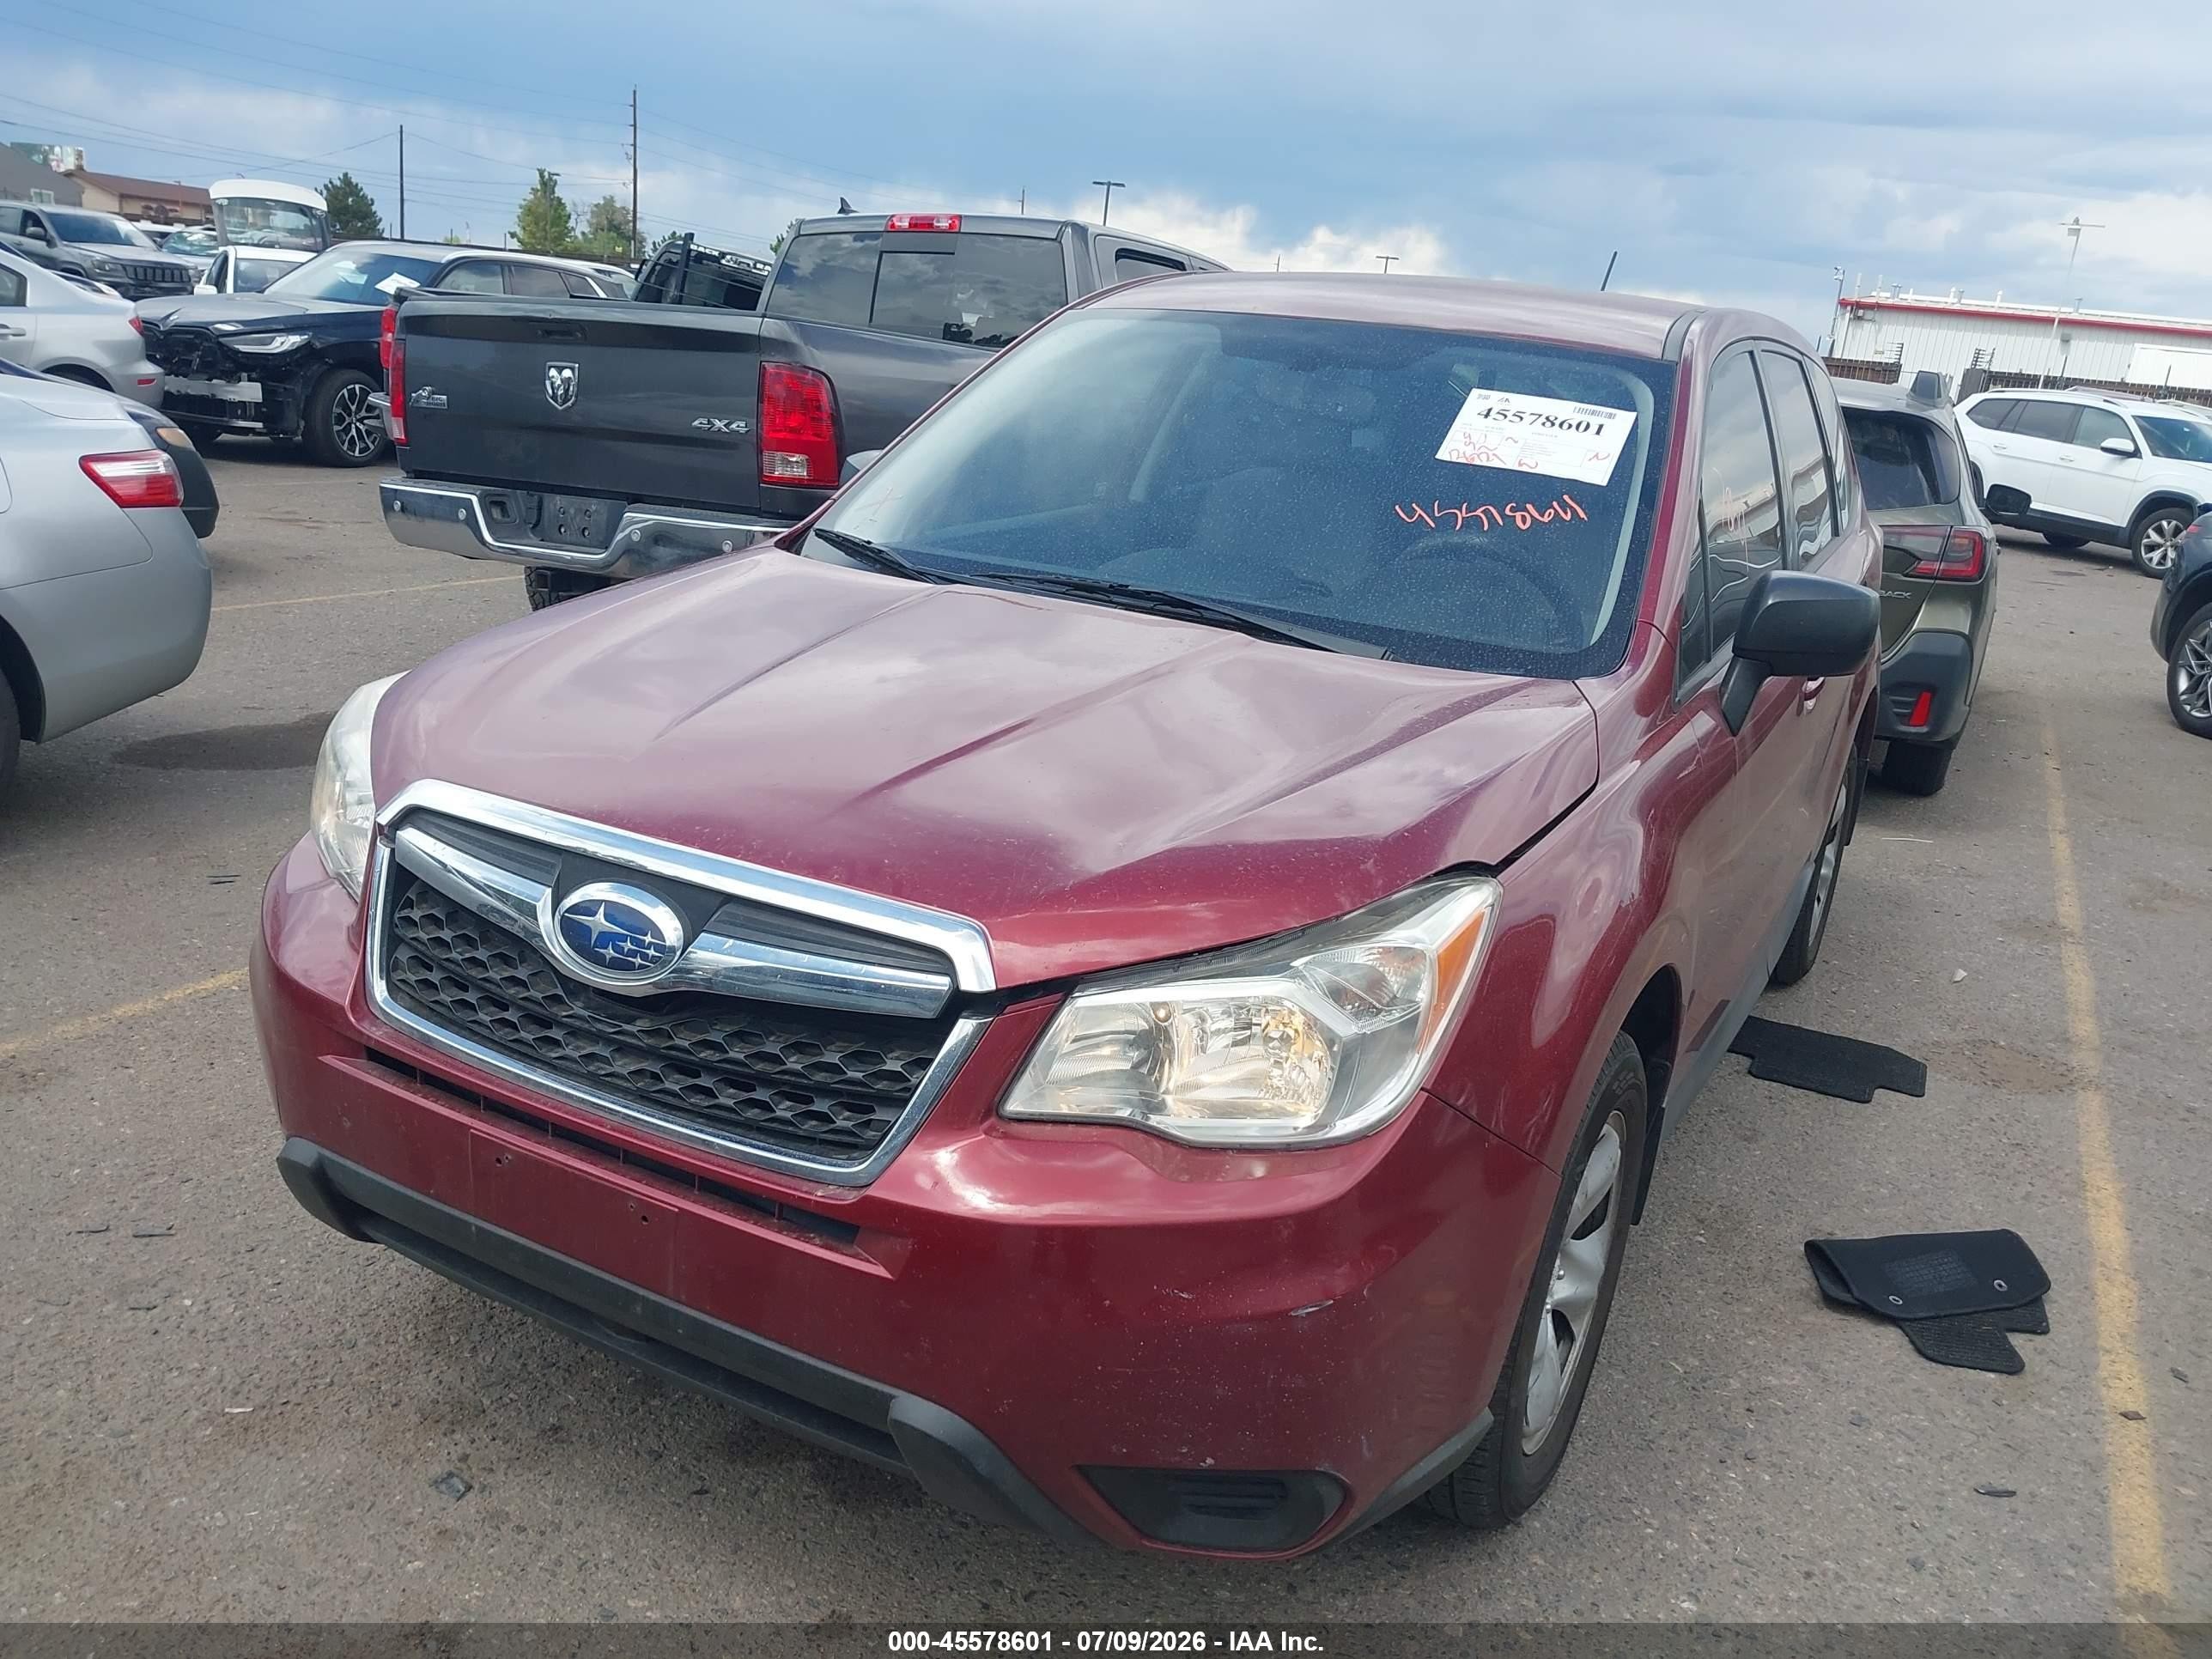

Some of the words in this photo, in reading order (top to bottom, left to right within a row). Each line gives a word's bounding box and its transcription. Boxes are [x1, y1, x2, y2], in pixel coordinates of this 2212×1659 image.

[690, 244, 720, 257] BACK
[691, 417, 750, 433] 4X4
[1476, 406, 1606, 436] 45578601
